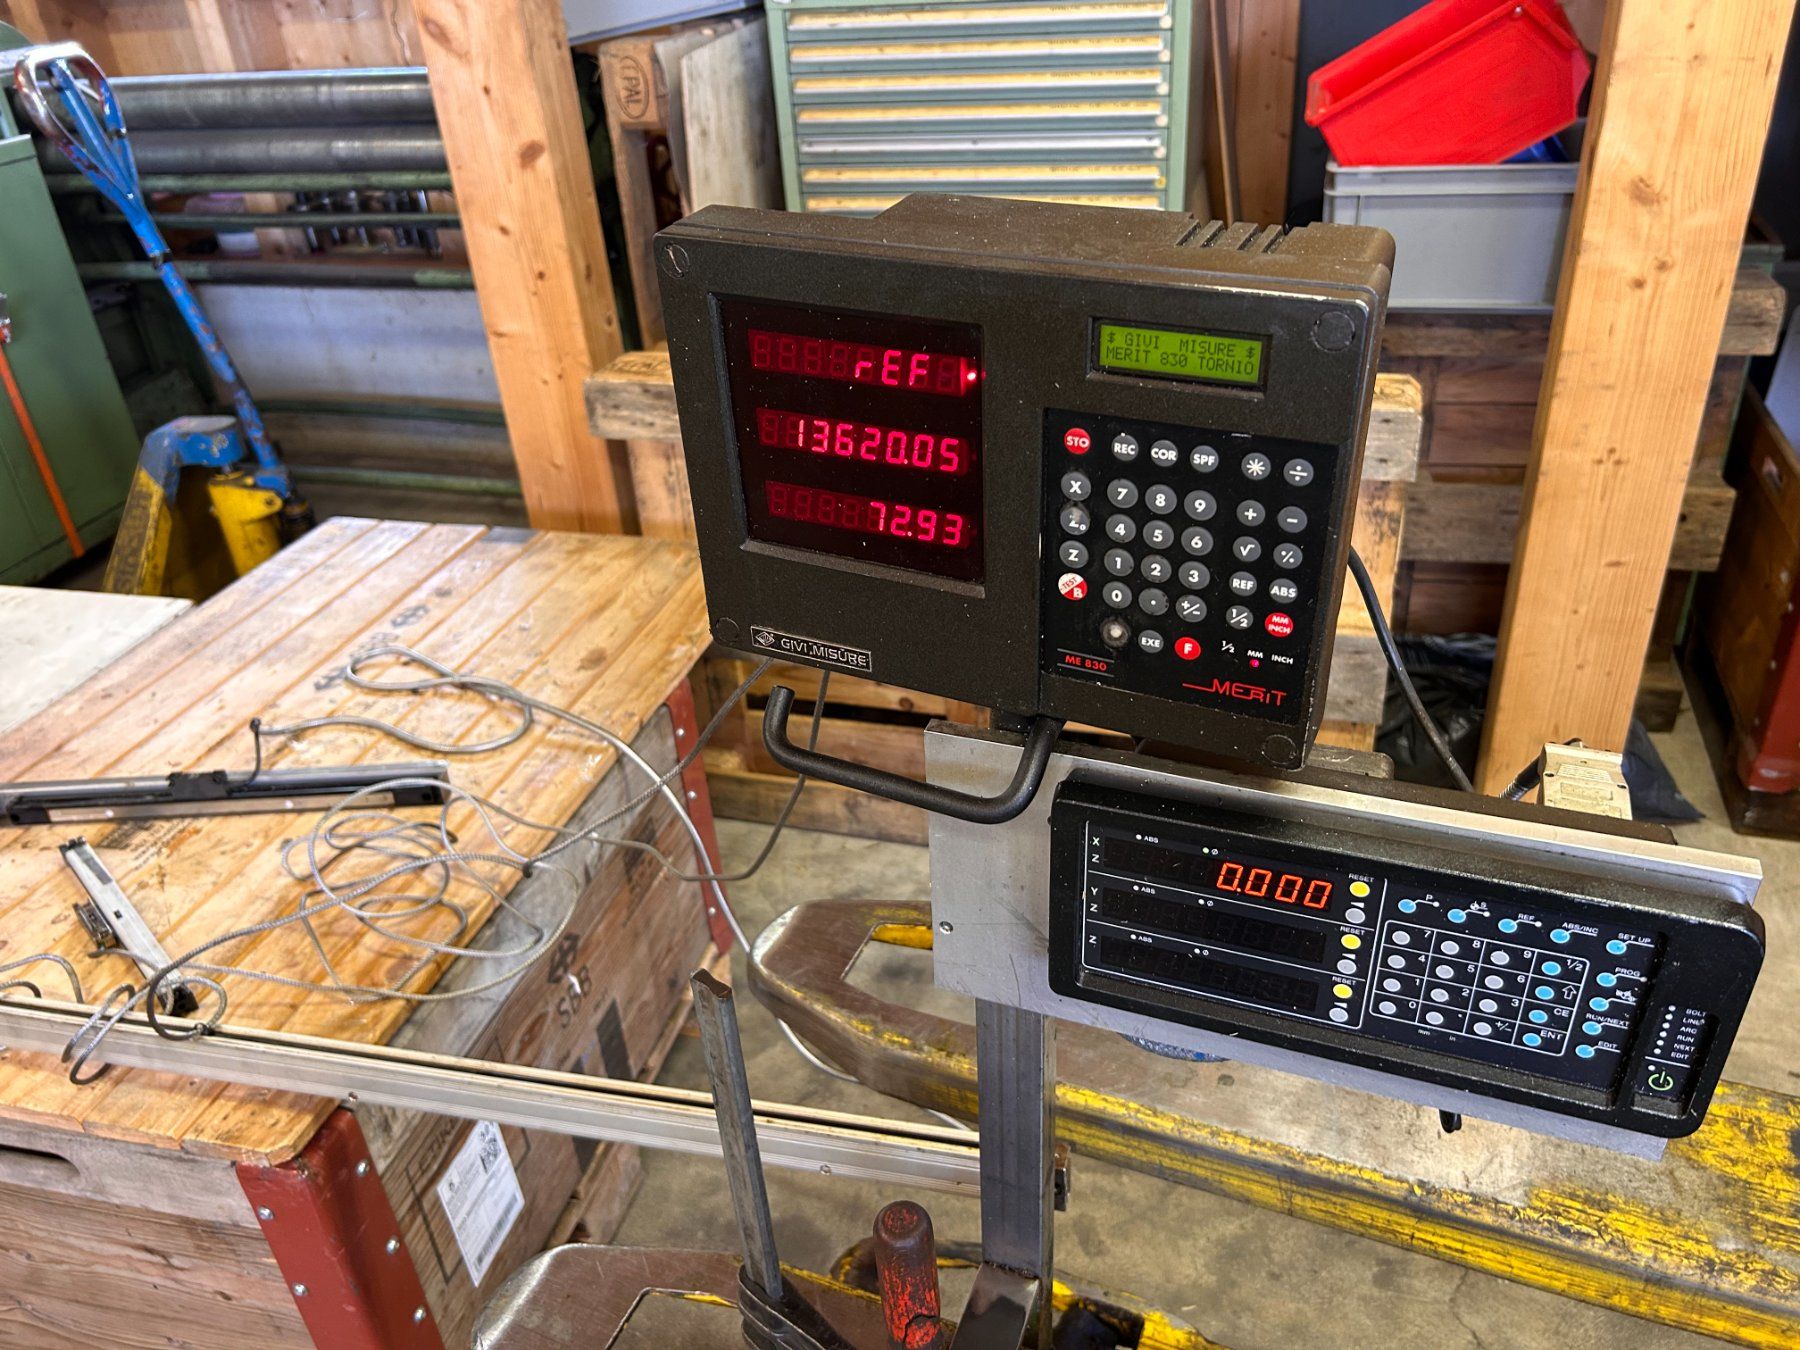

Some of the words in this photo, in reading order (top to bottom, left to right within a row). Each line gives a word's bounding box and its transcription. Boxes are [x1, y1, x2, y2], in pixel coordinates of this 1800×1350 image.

[1125, 332, 1160, 349] GIVI
[1179, 339, 1236, 358] MISURE
[1106, 345, 1150, 363] MERIT
[1160, 352, 1188, 367] 830
[1198, 356, 1254, 375] TORNIO
[854, 349, 930, 386] rEF
[797, 419, 959, 472] 13620.05
[1066, 436, 1089, 448] STO
[1114, 443, 1136, 455] REC
[1151, 448, 1177, 461] COR
[1193, 453, 1215, 466] SPF
[1069, 480, 1082, 494] X
[1117, 488, 1128, 500] 7
[1155, 493, 1166, 507] 8
[1194, 499, 1206, 513] 9
[870, 501, 963, 546] 72.93
[1114, 523, 1125, 536] 4
[1153, 529, 1163, 542] 5
[1191, 536, 1202, 549] 6
[1068, 549, 1079, 561] Z
[1115, 557, 1122, 569] 1
[1150, 563, 1161, 576] 2
[1188, 570, 1199, 582] 3
[1232, 578, 1254, 590] REF
[1073, 587, 1083, 599] B
[1111, 589, 1122, 602] 0
[1270, 586, 1296, 598] ABS
[1271, 615, 1289, 624] MM
[1268, 624, 1291, 635] INCH
[1141, 637, 1161, 648] EXE
[1184, 643, 1193, 655] F
[1065, 655, 1081, 666] ME
[1085, 659, 1107, 671] 830
[1247, 650, 1264, 659] MM
[1271, 654, 1293, 665] INCH
[1092, 837, 1100, 846] X
[1144, 836, 1159, 844] ABS
[1091, 853, 1100, 863] Z
[1348, 873, 1375, 883] RESET
[1141, 886, 1156, 895] ABS
[1216, 862, 1333, 909] 0.000
[1090, 887, 1099, 896] Y
[1090, 903, 1098, 912] Z
[1518, 913, 1535, 921] REF
[1340, 925, 1366, 936] RESET
[1562, 922, 1599, 934] ABS/INC
[1089, 935, 1097, 944] Z
[1138, 935, 1153, 943] ABS
[1424, 930, 1432, 938] 7
[1618, 933, 1636, 941] SET
[1638, 936, 1652, 944] UP
[1472, 940, 1481, 949] 8
[1418, 954, 1426, 963] 4
[1523, 950, 1532, 959] 9
[1467, 964, 1475, 973] 5
[1566, 959, 1583, 972] 1/2
[1615, 966, 1641, 977] PROG
[1332, 975, 1356, 986] RESET
[1517, 975, 1526, 983] 6
[1461, 988, 1470, 997] 2
[1408, 1001, 1417, 1009] 0
[1511, 998, 1520, 1007] 3
[1553, 1008, 1570, 1018] CE
[1685, 1008, 1707, 1017] BOLT
[1585, 1013, 1630, 1027] RUN/NEXT
[1540, 1029, 1564, 1041] ENT
[1680, 1026, 1698, 1034] ARC
[1676, 1034, 1695, 1043] RUN
[1598, 1040, 1618, 1049] EDIT
[1673, 1043, 1696, 1053] NEXT
[1671, 1051, 1690, 1060] EDIT
